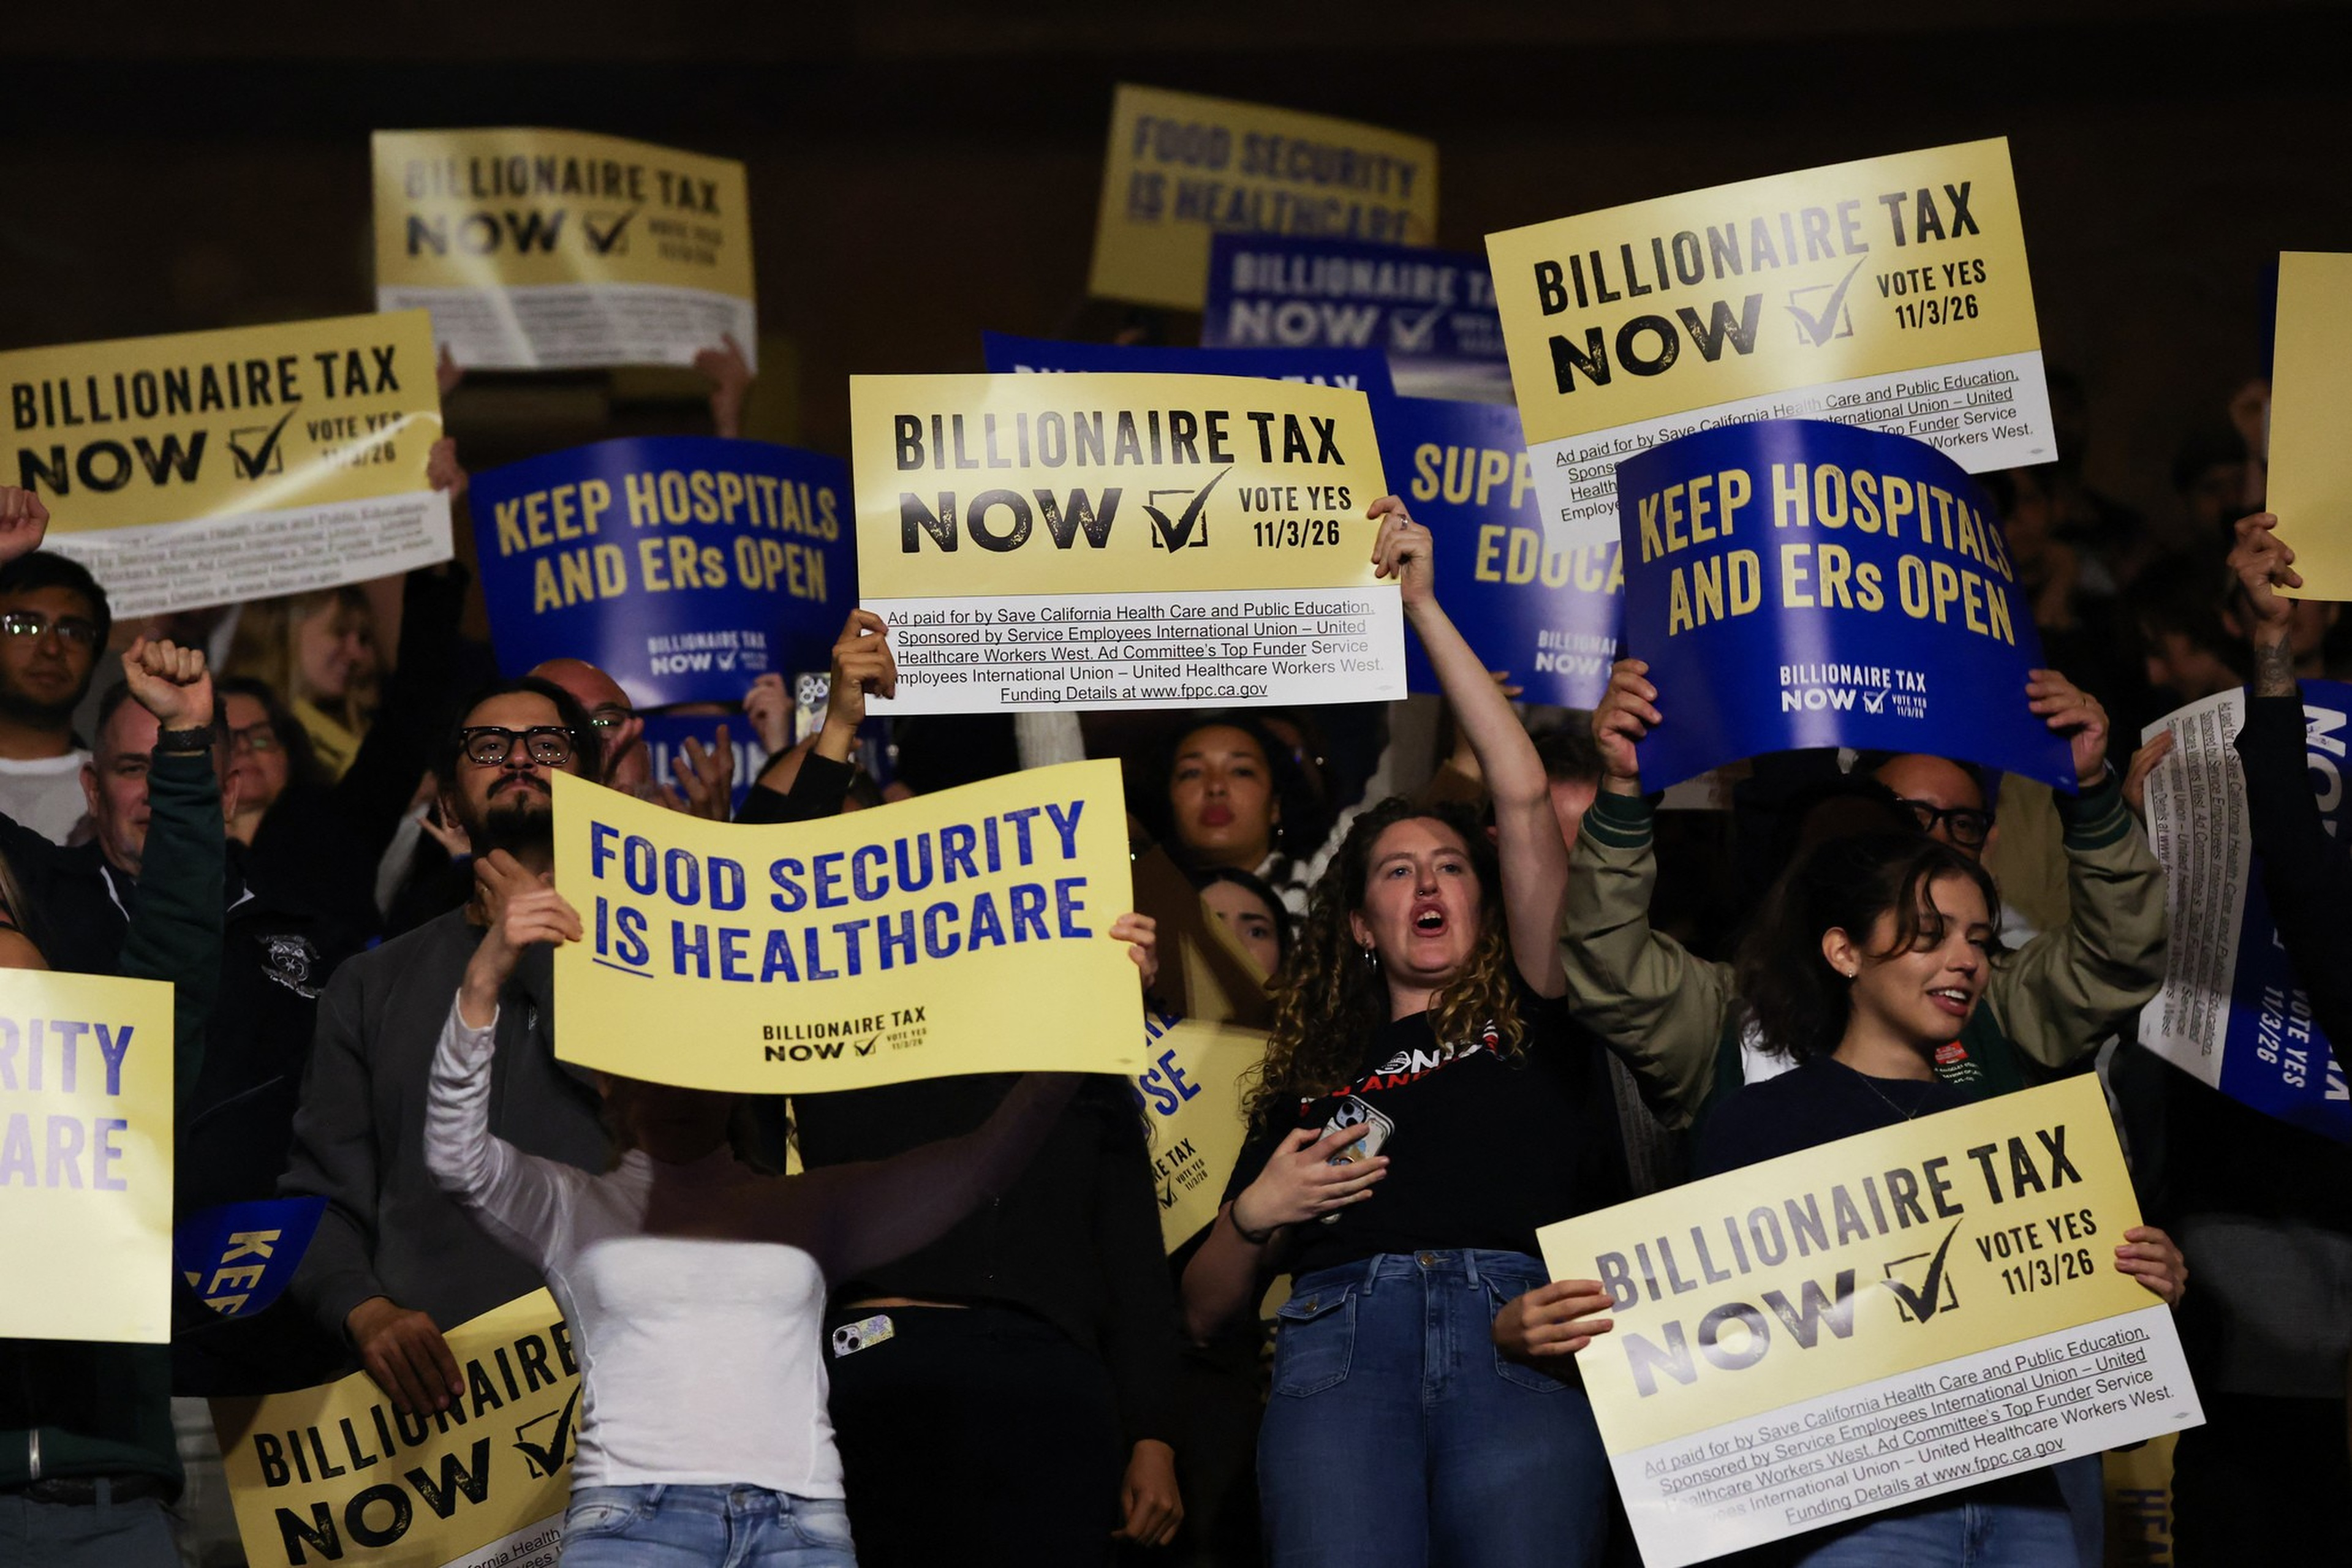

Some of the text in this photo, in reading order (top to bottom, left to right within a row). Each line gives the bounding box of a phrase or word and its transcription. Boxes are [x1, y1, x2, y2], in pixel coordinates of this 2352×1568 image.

[1133, 115, 1419, 198] FOOD SECURITY
[404, 156, 721, 214] BILLIONAIRE TAX
[1129, 170, 1410, 245] IS HEALTHCARE
[406, 209, 565, 257] NOW
[1534, 181, 1980, 315] BILLIONAIRE TAX
[1232, 252, 1456, 304] BILLIONAIRE
[1876, 258, 1987, 299] VOTE YES
[1228, 300, 1380, 350] NOW
[1895, 295, 1979, 330] 11/3/26
[1548, 293, 1763, 394] NOW
[12, 345, 400, 431] BILLIONAIRE TAX
[1908, 385, 2013, 415] Union United
[308, 418, 358, 442] VOTE
[894, 410, 1345, 470] BILLIONAIRE TAX
[1579, 370, 2019, 464] paid Care and Public Education.
[1909, 407, 2017, 433] Funder Service
[17, 431, 207, 497] NOW
[494, 479, 610, 556] KEEP
[624, 470, 838, 543] HOSPITALS
[899, 488, 1122, 552] NOW
[1239, 485, 1352, 512] VOTE YES
[1638, 463, 2013, 583] KEEP HOSPITALS
[1254, 519, 1339, 548] 11/3/26
[534, 535, 826, 613] AND ERs OPEN
[1669, 543, 2015, 646] AND ERs OPEN
[888, 600, 1374, 628] Ad paid for by Save California Health Care and Public Education.
[898, 619, 1366, 647] Sponsored by Service Employees International Union United
[648, 631, 739, 654] BILLIONAIRE
[651, 654, 711, 675] NOW
[898, 639, 1368, 664] Healthcare Workers West. Ad Top Funder Service
[1535, 653, 1599, 673] NOW
[973, 658, 1384, 681] International Union United Healthcare Workers West.
[1000, 683, 1268, 704] Funding Details www.fppc.ca.gov
[1780, 664, 1926, 693] BILLIONAIRE TAX
[1782, 688, 1856, 712] NOW
[1892, 694, 1910, 705] VOTE
[2301, 704, 2347, 837] NO
[591, 800, 1085, 912] FOOD SECURITY
[595, 876, 1092, 982] IS HEALTHCARE
[763, 1006, 925, 1040] BILLIONAIRE TAX
[887, 1027, 927, 1042] VOTE YES
[2256, 986, 2285, 1065] 11/3/26
[765, 1042, 844, 1061] NOW
[2282, 1046, 2309, 1088] YES
[1165, 1137, 1196, 1170] TAX
[1175, 1169, 1193, 1185] VOTE
[1191, 1158, 1206, 1172] YES
[1184, 1171, 1209, 1191] 11/3/26
[1595, 1125, 2082, 1314] BILLIONAIRE TAX
[1976, 1208, 2097, 1263] VOTE YES
[2001, 1248, 2094, 1295] 11/3/26
[1621, 1268, 1855, 1397] NOW
[1884, 1330, 2150, 1407] Health Care Public Education.
[1660, 1347, 2146, 1494] Sponsored Service Employees International Union United
[1755, 1371, 2153, 1490] Workers West. Funder Service
[1750, 1472, 1849, 1512] International
[1853, 1460, 1900, 1483] Union
[1918, 1439, 1970, 1464] United
[1973, 1418, 2059, 1450] Healthcare
[2062, 1399, 2127, 1426] Workers
[2130, 1386, 2174, 1408] West.
[275, 1437, 490, 1566] NOW
[1785, 1439, 2064, 1523] Funding Details www.fppc.ca.gov
[512, 1528, 561, 1557] Health
